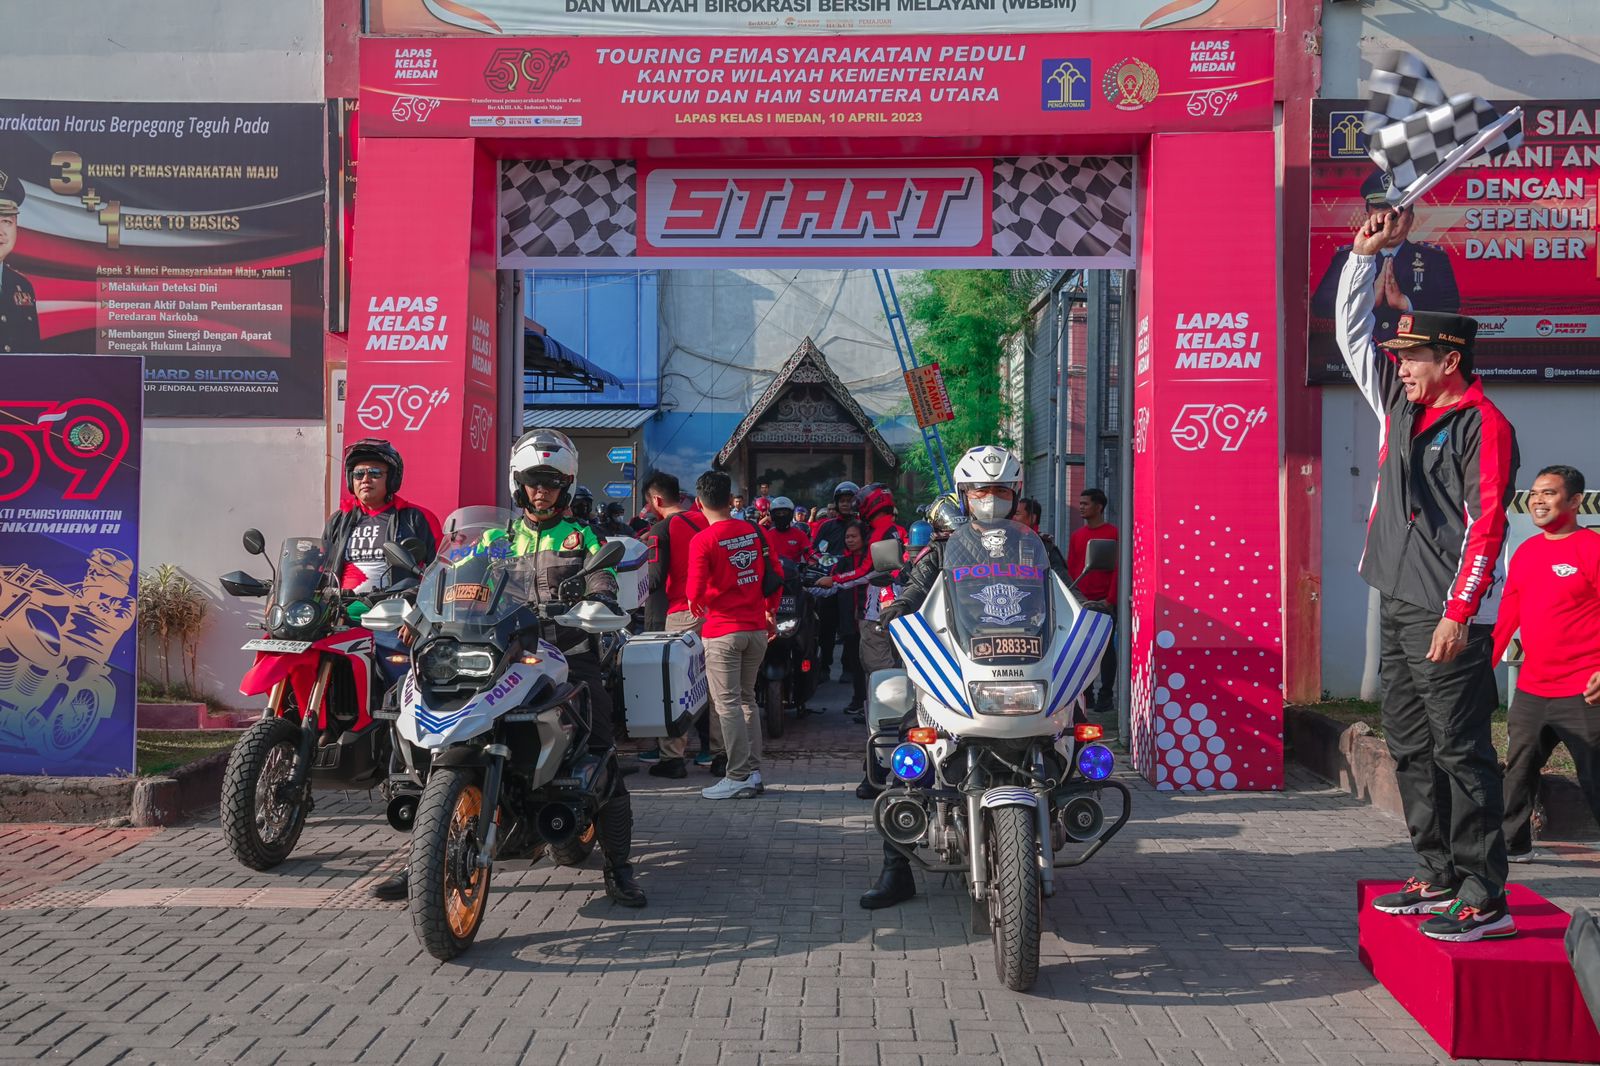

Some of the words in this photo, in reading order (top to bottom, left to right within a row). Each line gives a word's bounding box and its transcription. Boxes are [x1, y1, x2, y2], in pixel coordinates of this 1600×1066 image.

[566, 0, 604, 12] DAN
[612, 0, 698, 12] WILAYAH
[705, 0, 812, 12] BIROKRASI
[818, 0, 890, 12] BERSIH
[898, 0, 995, 11] MELAYANI
[1002, 0, 1076, 13] (WBBM)
[395, 48, 432, 58] LAPAS
[1190, 40, 1230, 50] LAPAS
[596, 48, 702, 64] TOURING
[708, 46, 932, 64] PEMASYARAKATAN
[939, 45, 1026, 62] PEDULI
[1190, 52, 1228, 61] KELAS
[1230, 51, 1235, 60] I
[394, 59, 430, 68] KELAS
[432, 59, 438, 68] I
[1190, 62, 1236, 72] MEDAN
[394, 70, 438, 78] MEDAN
[637, 69, 724, 83] KANTOR
[731, 68, 824, 83] WILAYAH
[830, 67, 985, 82] KEMENTERIAN
[621, 90, 700, 104] HUKUM
[706, 90, 748, 104] DAN
[755, 89, 802, 104] HAM
[808, 88, 922, 103] SUMATERA
[930, 87, 1000, 102] UTARA
[675, 114, 716, 123] LAPAS
[720, 114, 764, 123] KELAS
[767, 114, 772, 123] I
[775, 113, 826, 124] MEDAN,
[829, 113, 844, 123] 10
[848, 112, 888, 123] APRIL
[892, 112, 922, 122] 2023
[64, 116, 106, 132] Harus
[110, 116, 184, 138] Berpegang
[189, 117, 230, 138] Teguh
[234, 118, 270, 134] Pada
[50, 150, 83, 195] 3
[88, 164, 125, 177] KUNCI
[130, 165, 242, 179] PEMASYARAKATAN
[246, 166, 279, 180] MAJU
[1466, 178, 1584, 199] DENGAN
[660, 177, 976, 240] START
[99, 200, 120, 249] 1
[124, 215, 162, 230] BACK
[166, 215, 185, 230] TO
[189, 216, 240, 231] BASICS
[1465, 208, 1590, 230] SEPENUH
[1466, 238, 1524, 260] DAN
[1534, 238, 1586, 260] BER
[96, 266, 122, 276] Aspek
[125, 266, 131, 275] 3
[134, 266, 159, 276] Kunci
[161, 267, 233, 278] Pemasyarakatan
[236, 268, 259, 278] Maju,
[262, 267, 285, 278] yakni
[108, 282, 159, 292] Melakukan
[162, 282, 197, 293] Deteksi
[200, 283, 218, 293] Dini
[108, 300, 151, 311] Berperan
[154, 300, 176, 310] Aktif
[178, 301, 208, 310] Dalam
[211, 302, 283, 311] Pemberantasan
[368, 296, 438, 313] LAPAS
[108, 312, 157, 321] Peredaran
[160, 312, 198, 322] Narkoba
[367, 316, 435, 332] KELAS
[438, 316, 447, 332] I
[1176, 312, 1249, 330] LAPAS
[472, 316, 490, 336] LAPAS
[108, 329, 165, 341] Membangun
[168, 330, 200, 341] Sinergi
[204, 330, 238, 341] Dengan
[241, 331, 272, 341] Aparat
[365, 334, 449, 351] MEDAN
[1176, 332, 1246, 349] KELAS
[1250, 332, 1259, 349] I
[108, 342, 148, 352] Penegak
[150, 342, 183, 351] Hukum
[186, 342, 222, 353] Lainnya
[472, 337, 489, 354] KELAS
[472, 356, 492, 376] MEDAN
[1175, 352, 1261, 369] MEDAN
[144, 369, 190, 380] HARD
[194, 370, 279, 380] SILITONGA
[926, 378, 941, 410] TAMU
[935, 370, 951, 412] PERHATIAN
[357, 384, 450, 430] 59th
[1170, 404, 1268, 452] 59th
[17, 509, 122, 520] PEMASYARAKATAN
[100, 523, 120, 534] RI
[953, 563, 1044, 582] POLISI
[996, 638, 1039, 654] 28833-II
[992, 670, 1024, 678] YAMAHA
[485, 672, 523, 706] POLISI
